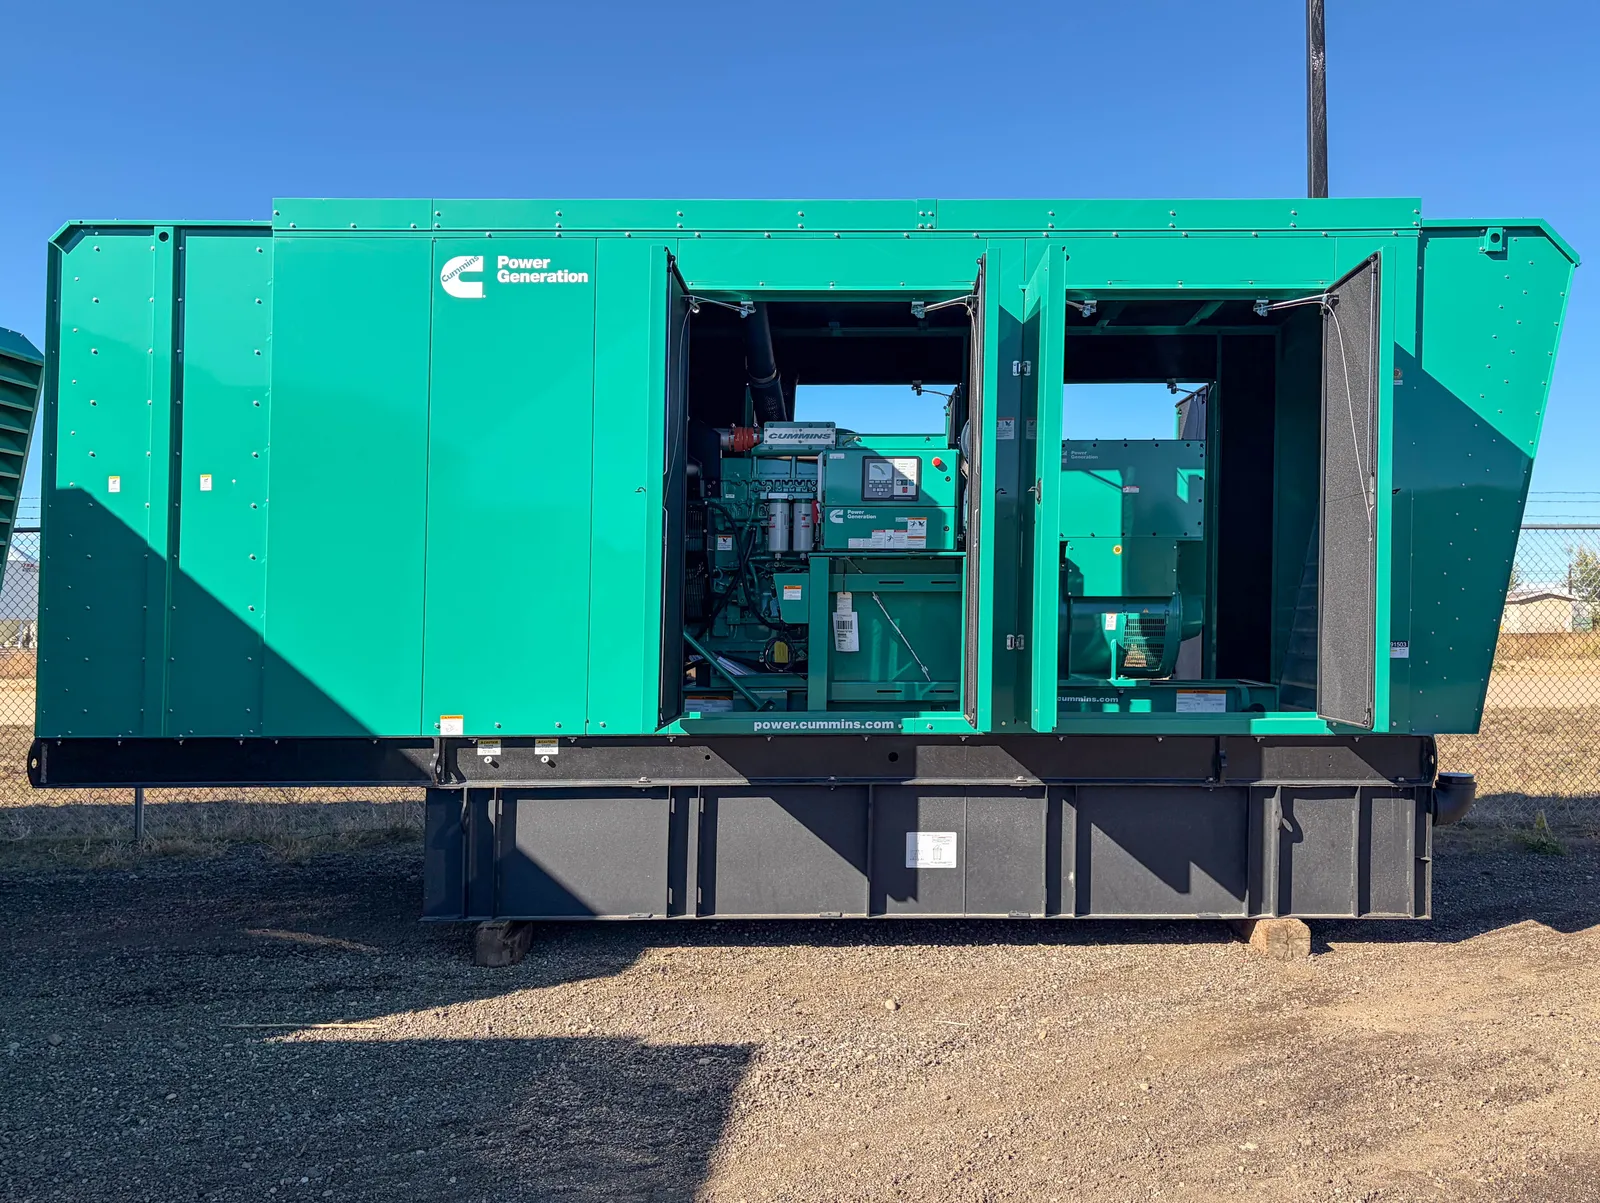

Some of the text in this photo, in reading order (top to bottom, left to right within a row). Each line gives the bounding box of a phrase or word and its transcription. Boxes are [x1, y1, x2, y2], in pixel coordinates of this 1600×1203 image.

[497, 255, 551, 269] Power
[441, 256, 479, 283] Cummins
[497, 269, 589, 283] Generation
[753, 719, 894, 731] power.cummins.com
